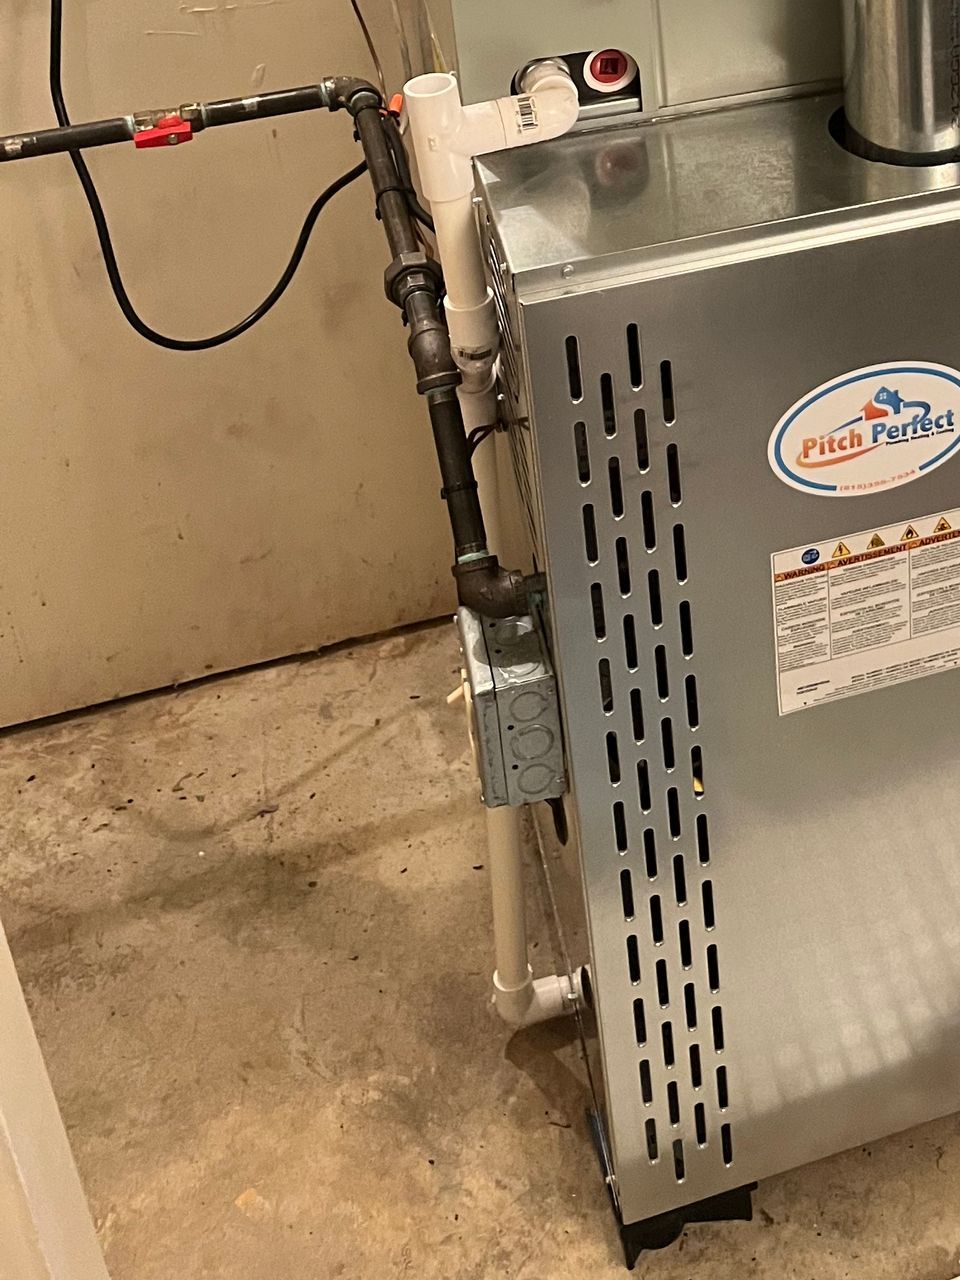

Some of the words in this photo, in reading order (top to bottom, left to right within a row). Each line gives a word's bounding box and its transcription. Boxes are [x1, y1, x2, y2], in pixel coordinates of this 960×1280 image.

[802, 428, 862, 459] Pitch
[872, 410, 955, 444] Perfect
[784, 566, 826, 580] WARNING
[837, 544, 907, 567] AVERTISSEMENT
